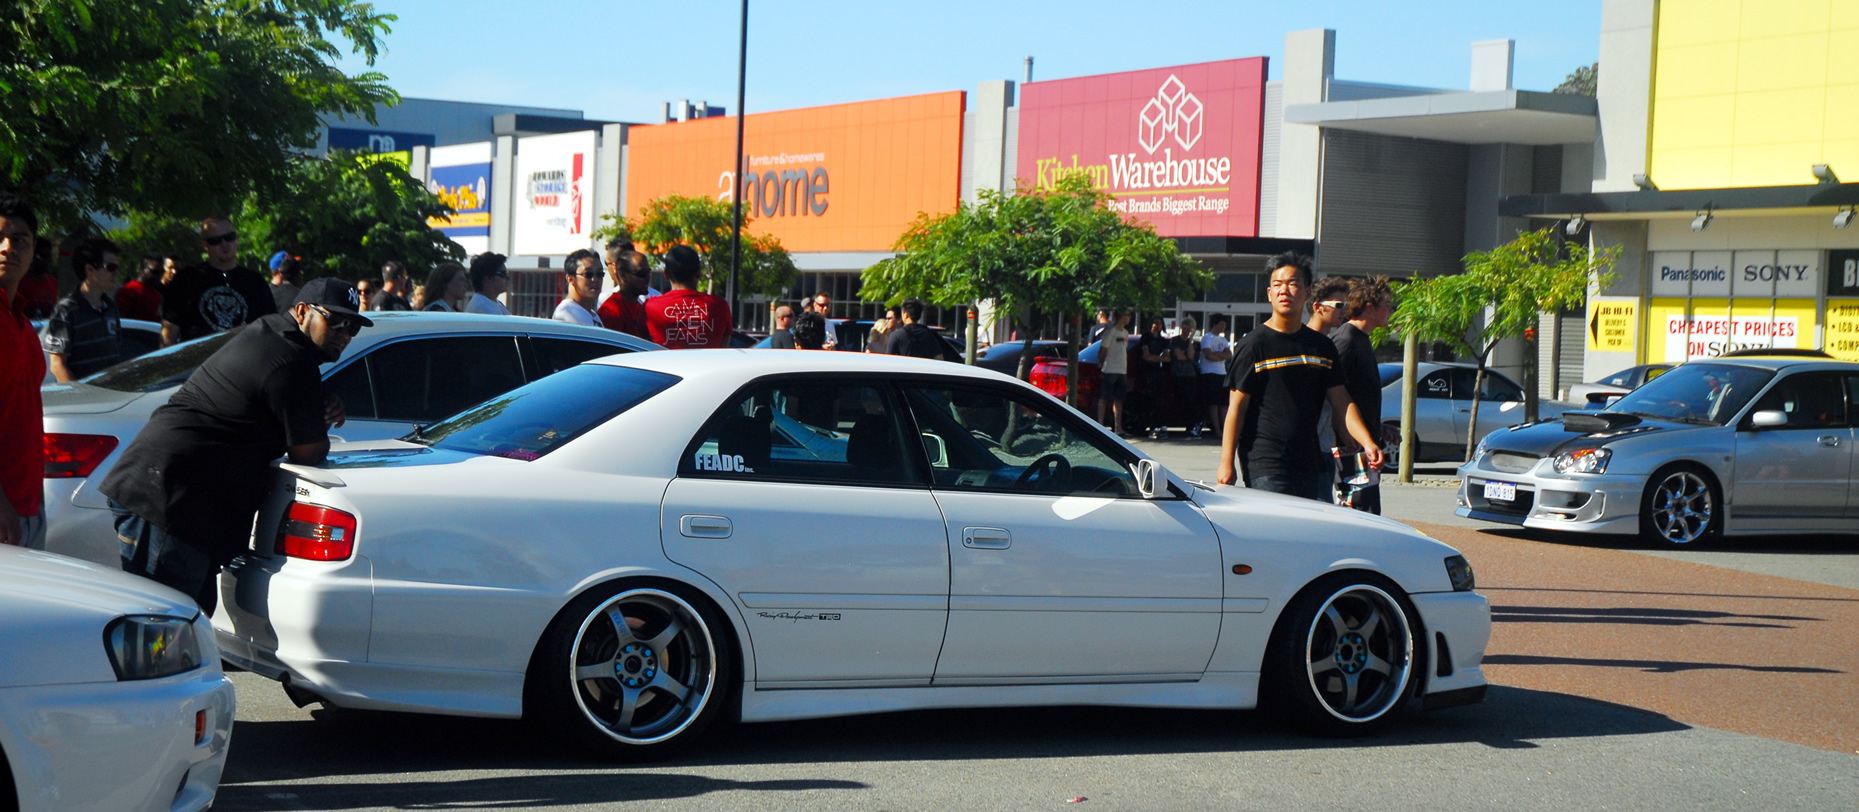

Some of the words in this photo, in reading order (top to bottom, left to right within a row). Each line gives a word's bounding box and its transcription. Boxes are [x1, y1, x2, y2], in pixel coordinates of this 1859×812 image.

[1036, 154, 1110, 192] Kitchen
[1109, 147, 1231, 189] Warehouse
[742, 154, 830, 218] home
[1129, 196, 1162, 213] Brands
[1162, 196, 1197, 215] Biggest
[1198, 195, 1230, 214] Range
[1660, 265, 1726, 282] Panasonic
[1744, 264, 1809, 282] SONY
[1600, 306, 1611, 316] JB
[1669, 319, 1740, 335] CHEAPEST
[1744, 320, 1796, 337] PRICES
[1688, 341, 1705, 356] ON
